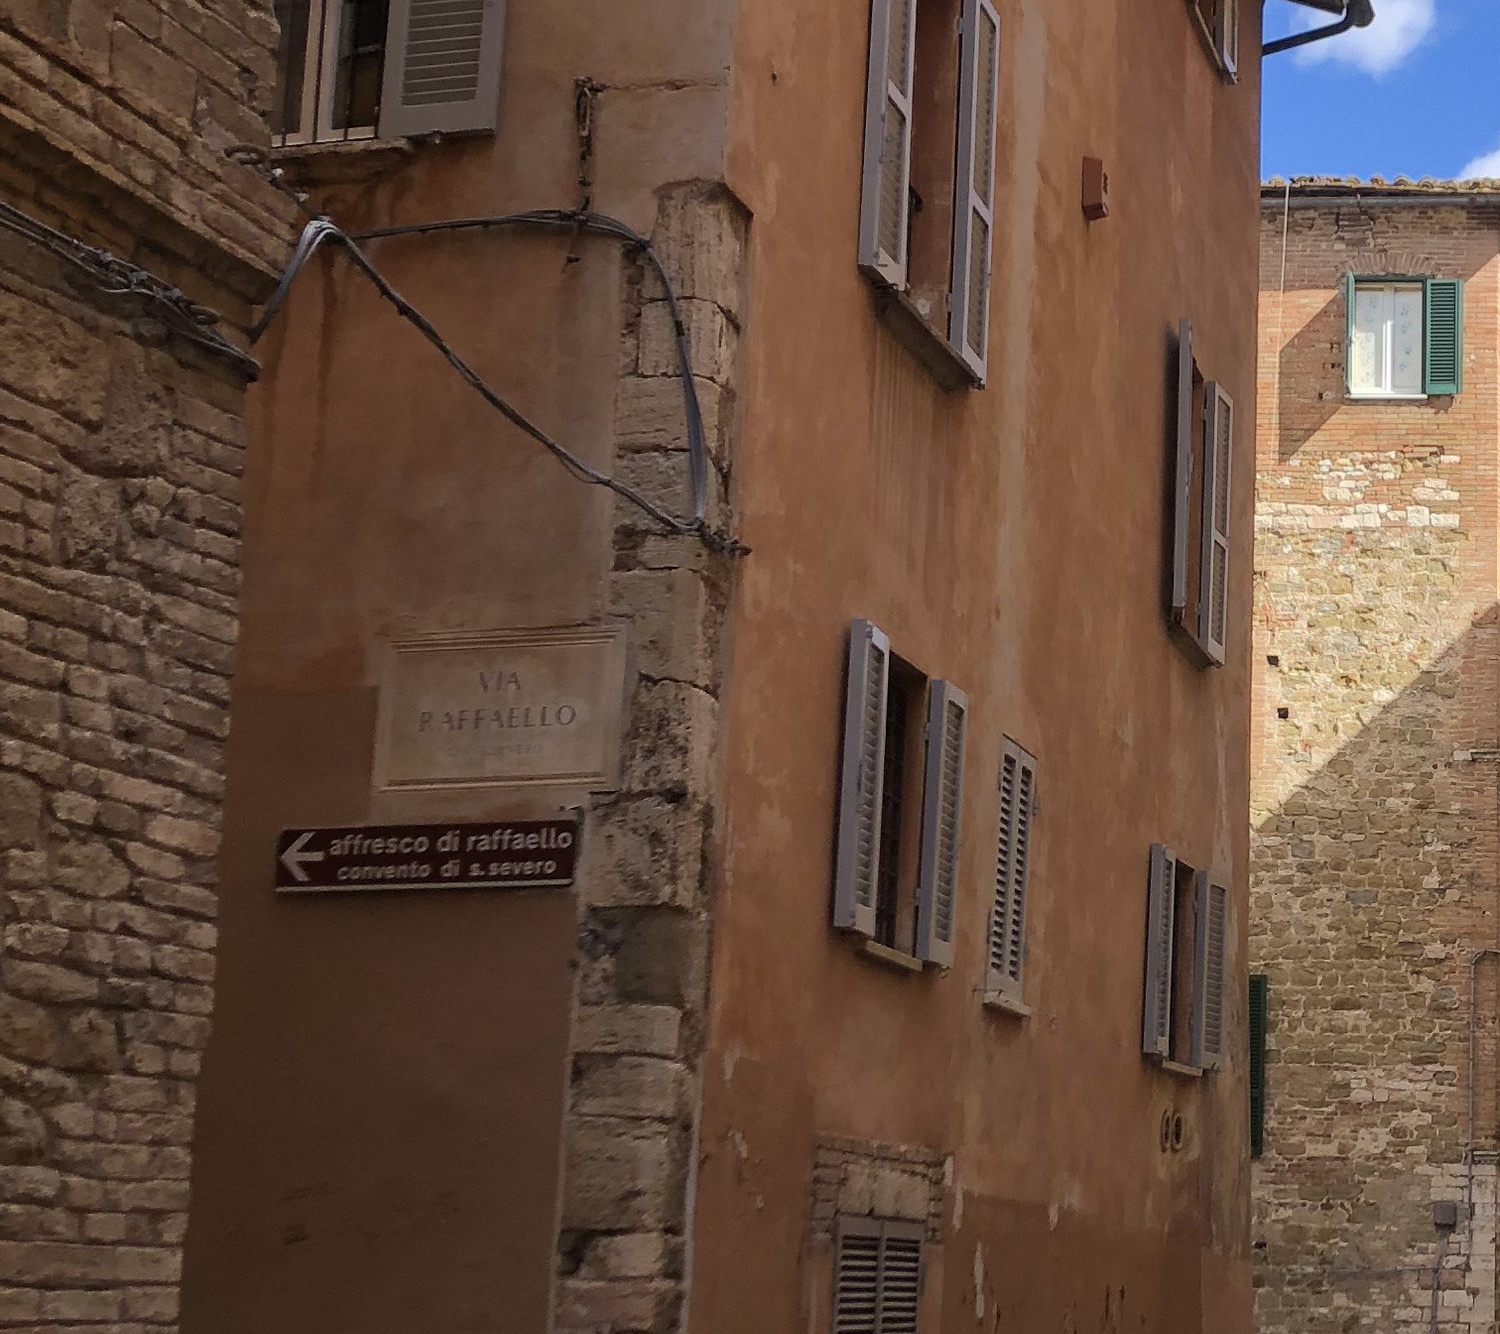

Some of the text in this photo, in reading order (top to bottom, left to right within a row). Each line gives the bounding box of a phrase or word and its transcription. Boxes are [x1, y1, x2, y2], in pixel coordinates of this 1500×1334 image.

[478, 670, 522, 691] VIA
[418, 704, 576, 733] RAFFAELLO
[329, 827, 573, 856] affresco di raffaello
[337, 861, 431, 881] convento
[440, 859, 461, 878] di
